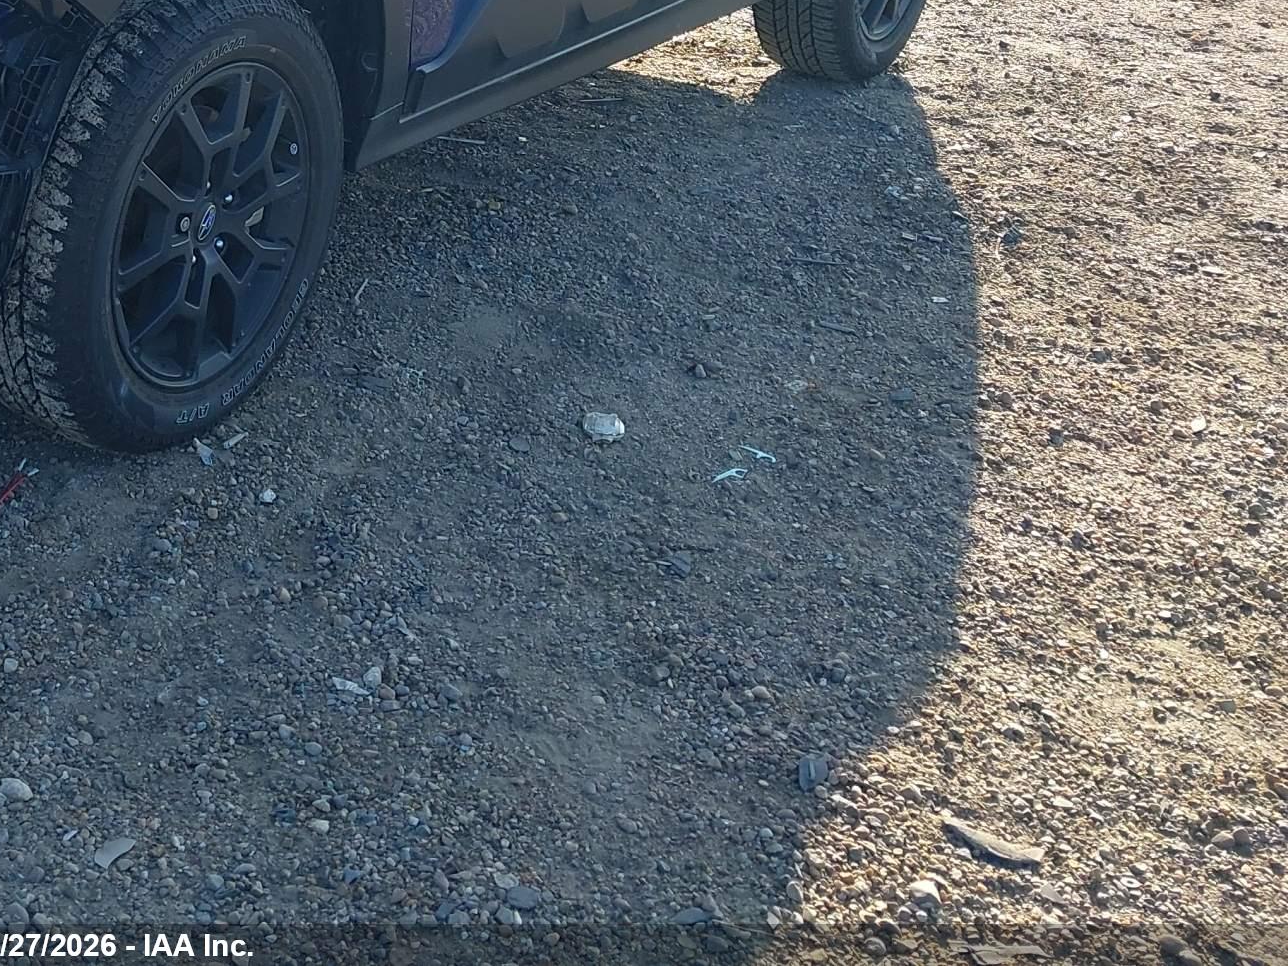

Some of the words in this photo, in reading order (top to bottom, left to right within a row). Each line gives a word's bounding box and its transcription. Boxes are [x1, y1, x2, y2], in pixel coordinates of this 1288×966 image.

[152, 36, 246, 123] YOKOHAMA
[221, 278, 309, 406] GEOLANDAR
[176, 402, 210, 424] A/T
